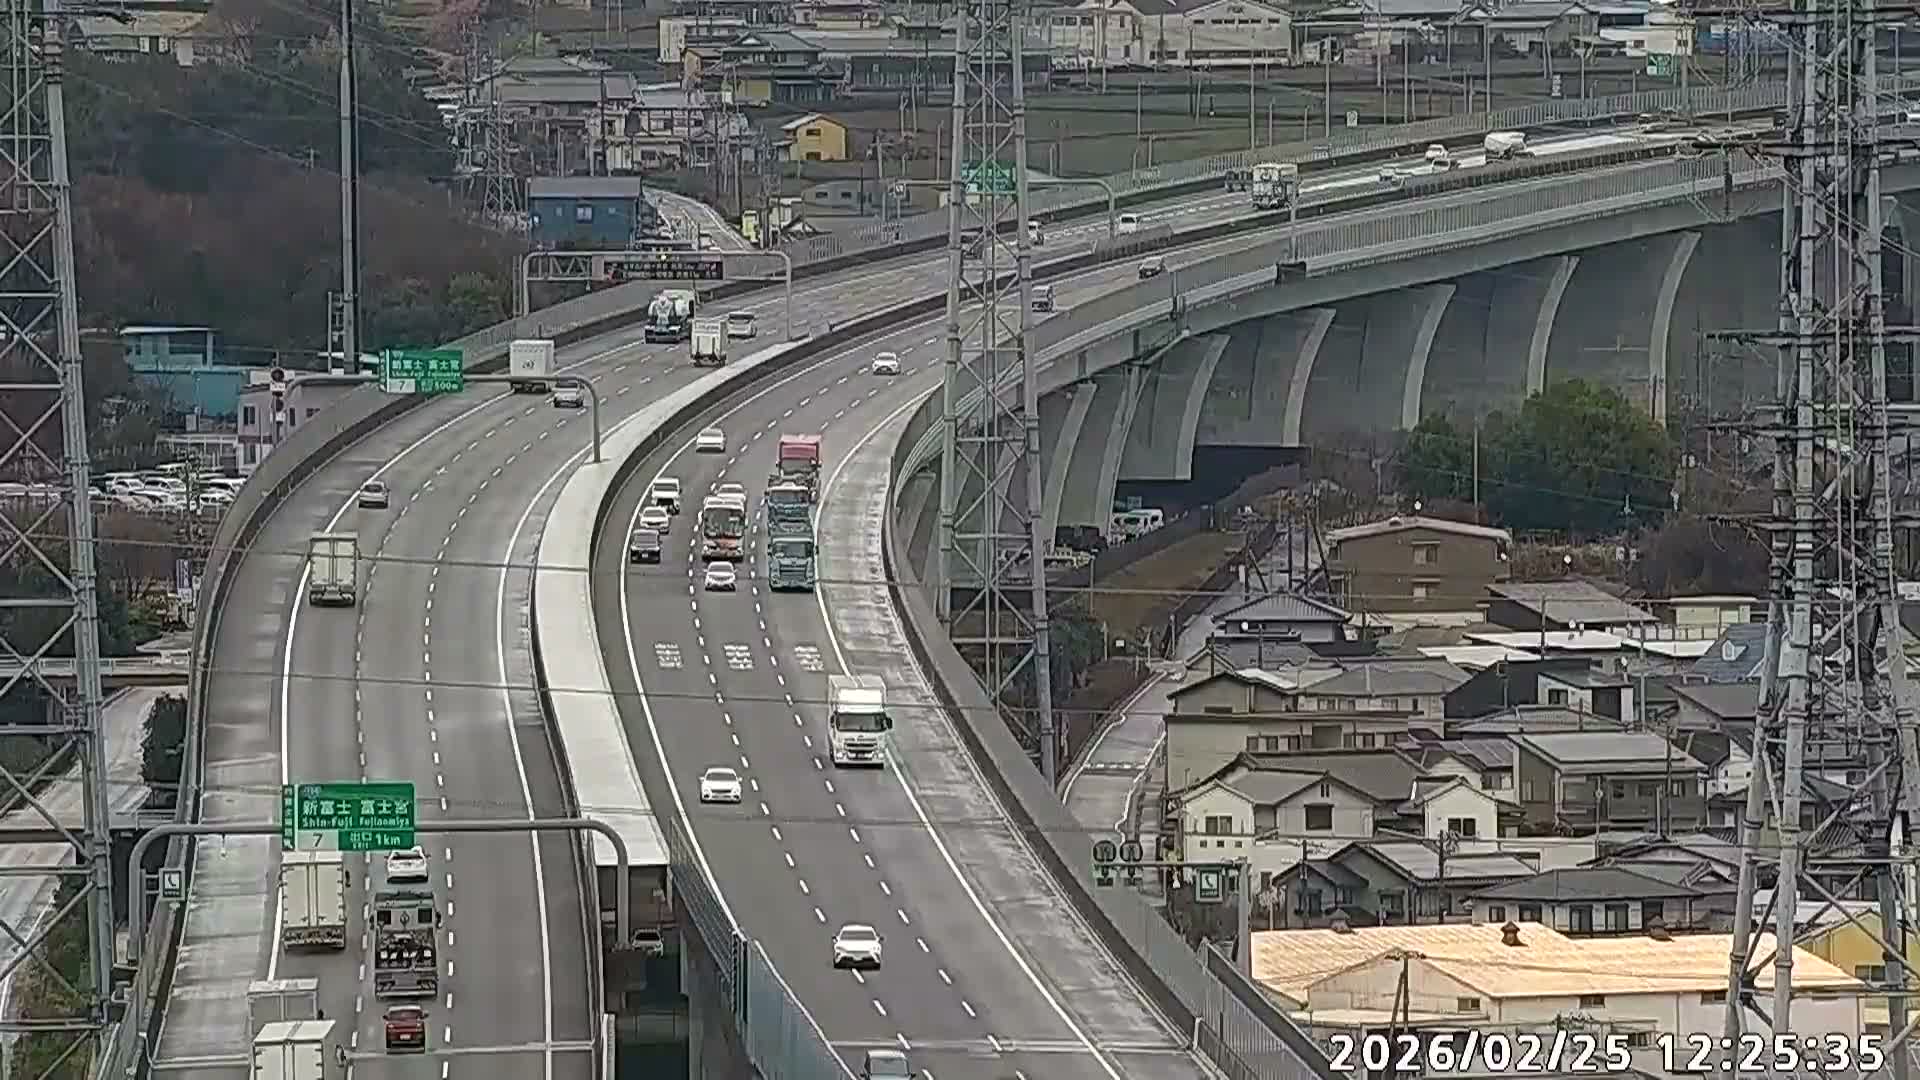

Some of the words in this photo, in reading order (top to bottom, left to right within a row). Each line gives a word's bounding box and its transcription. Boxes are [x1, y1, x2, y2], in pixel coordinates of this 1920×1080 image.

[399, 381, 406, 391] 7
[302, 800, 352, 815] 新富士
[360, 800, 409, 815] 富士宮
[312, 833, 323, 847] 7
[350, 831, 373, 842] 出口
